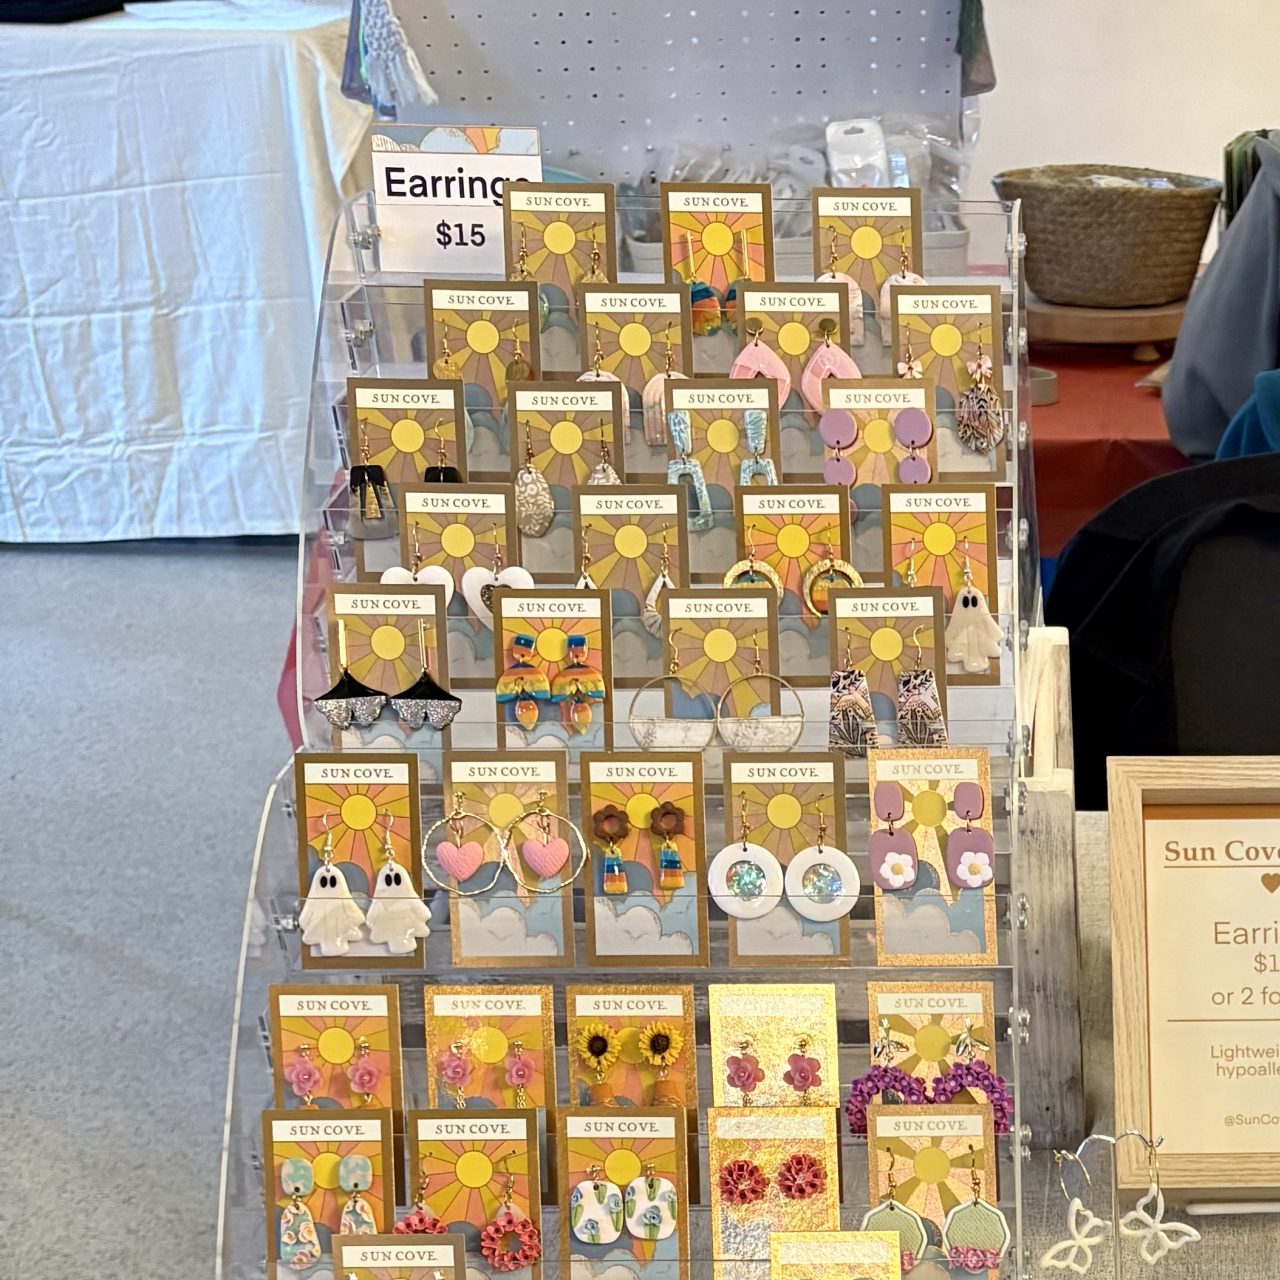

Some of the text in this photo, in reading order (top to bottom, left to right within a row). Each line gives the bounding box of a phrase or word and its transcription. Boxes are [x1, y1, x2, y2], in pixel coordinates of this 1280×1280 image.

[384, 167, 529, 207] Earring
[526, 197, 591, 207] SUN COVE
[684, 197, 749, 207] SUN COVE
[833, 202, 897, 211] SUN COVE
[436, 219, 486, 249] $15
[448, 295, 515, 305] SUN COVE
[600, 298, 666, 308] SUN COVE
[760, 297, 825, 307] SUN COVE
[913, 299, 978, 309] SUN COVE
[372, 393, 440, 404] SUN COVE
[531, 396, 598, 406] SUN COVE
[688, 394, 755, 404] SUN COVE
[845, 393, 872, 404] SUN
[421, 498, 491, 508] SUN COVE
[596, 499, 663, 509] SUN COVE
[758, 499, 825, 509] SUN COVE
[905, 498, 972, 507] SUN COVE
[351, 599, 421, 609] SUN COVE
[517, 603, 586, 613] SUN COVE
[685, 603, 753, 613] SUN COVE
[851, 602, 919, 612] SUN COVE
[321, 768, 394, 778] SUN COVE
[468, 767, 541, 777] SUN COVE
[606, 767, 678, 777] SUN COVE
[747, 768, 819, 778] SUN COVE
[892, 764, 921, 775] SUN
[1165, 841, 1215, 861] Sun
[1211, 991, 1234, 1005] or
[1241, 987, 1254, 1005] 2
[297, 1000, 372, 1011] SUN COVE
[452, 1000, 481, 1010] SUN
[593, 1000, 668, 1010] SUN COVE
[894, 998, 924, 1009] SUN
[289, 1125, 365, 1135] SUN COVE
[435, 1124, 511, 1134] SUN COVE
[584, 1122, 659, 1132] SUN COVE
[893, 1120, 924, 1131] SUN
[360, 1251, 438, 1262] SUN COVE
